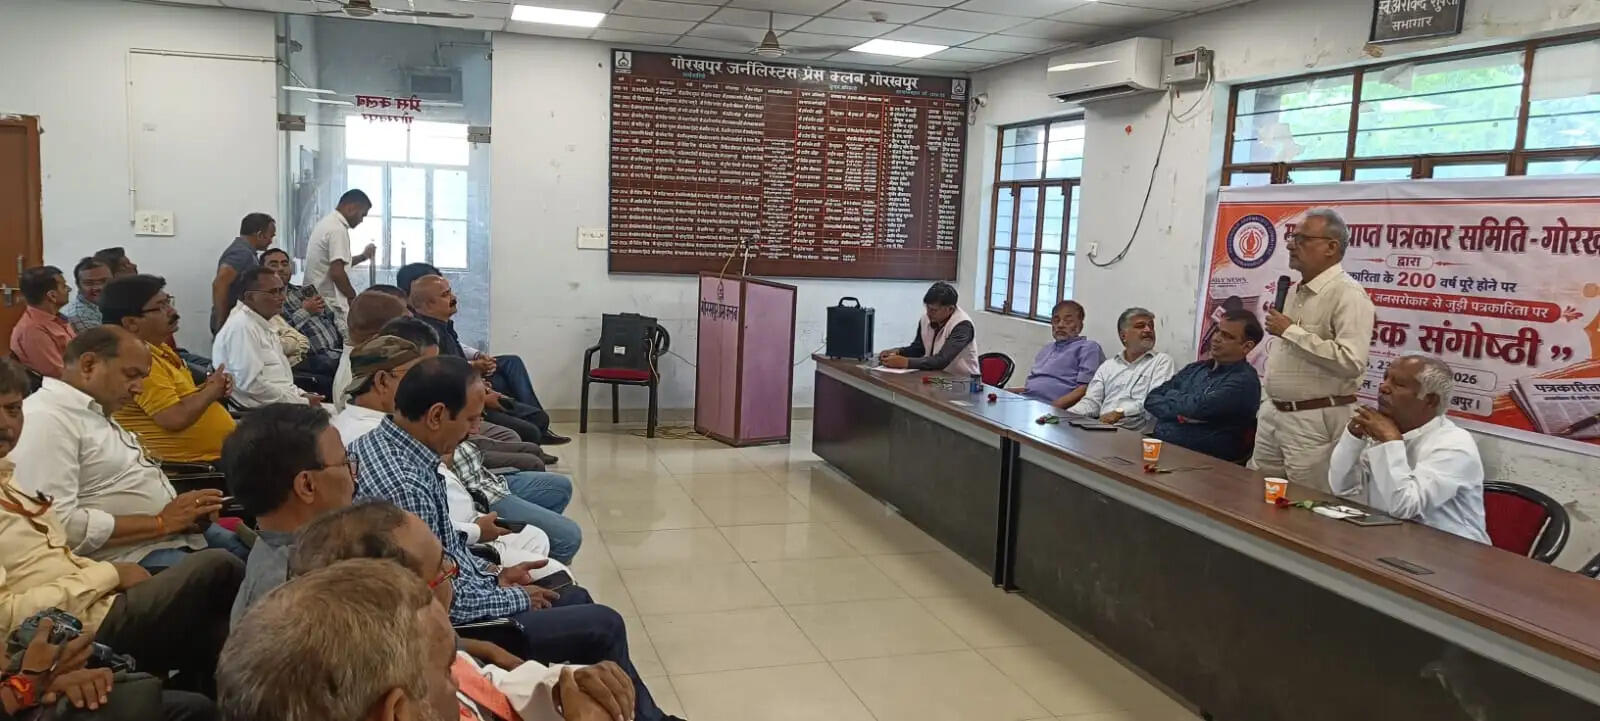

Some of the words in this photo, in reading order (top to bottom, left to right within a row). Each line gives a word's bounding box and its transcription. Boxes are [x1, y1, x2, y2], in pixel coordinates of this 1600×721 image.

[1391, 16, 1433, 31] सभागार
[670, 56, 723, 75] गोरखपुर
[803, 66, 825, 82] प्रेस
[869, 72, 919, 91] गोरखपुर
[1386, 224, 1455, 251] पत्रकार
[1396, 256, 1422, 267] द्वारा
[1382, 271, 1395, 284] के
[1396, 272, 1437, 289] 200
[1440, 276, 1458, 289] वर्ष
[1459, 277, 1475, 293] पूरे
[1476, 278, 1499, 292] होने
[1500, 281, 1519, 293] पर
[1375, 293, 1429, 308] जनसरोकार
[1431, 296, 1443, 309] से
[1470, 301, 1529, 317] पत्रकारिता
[1531, 306, 1550, 319] पर
[1418, 320, 1545, 368] संगोष्ठी
[1454, 372, 1478, 385] 026
